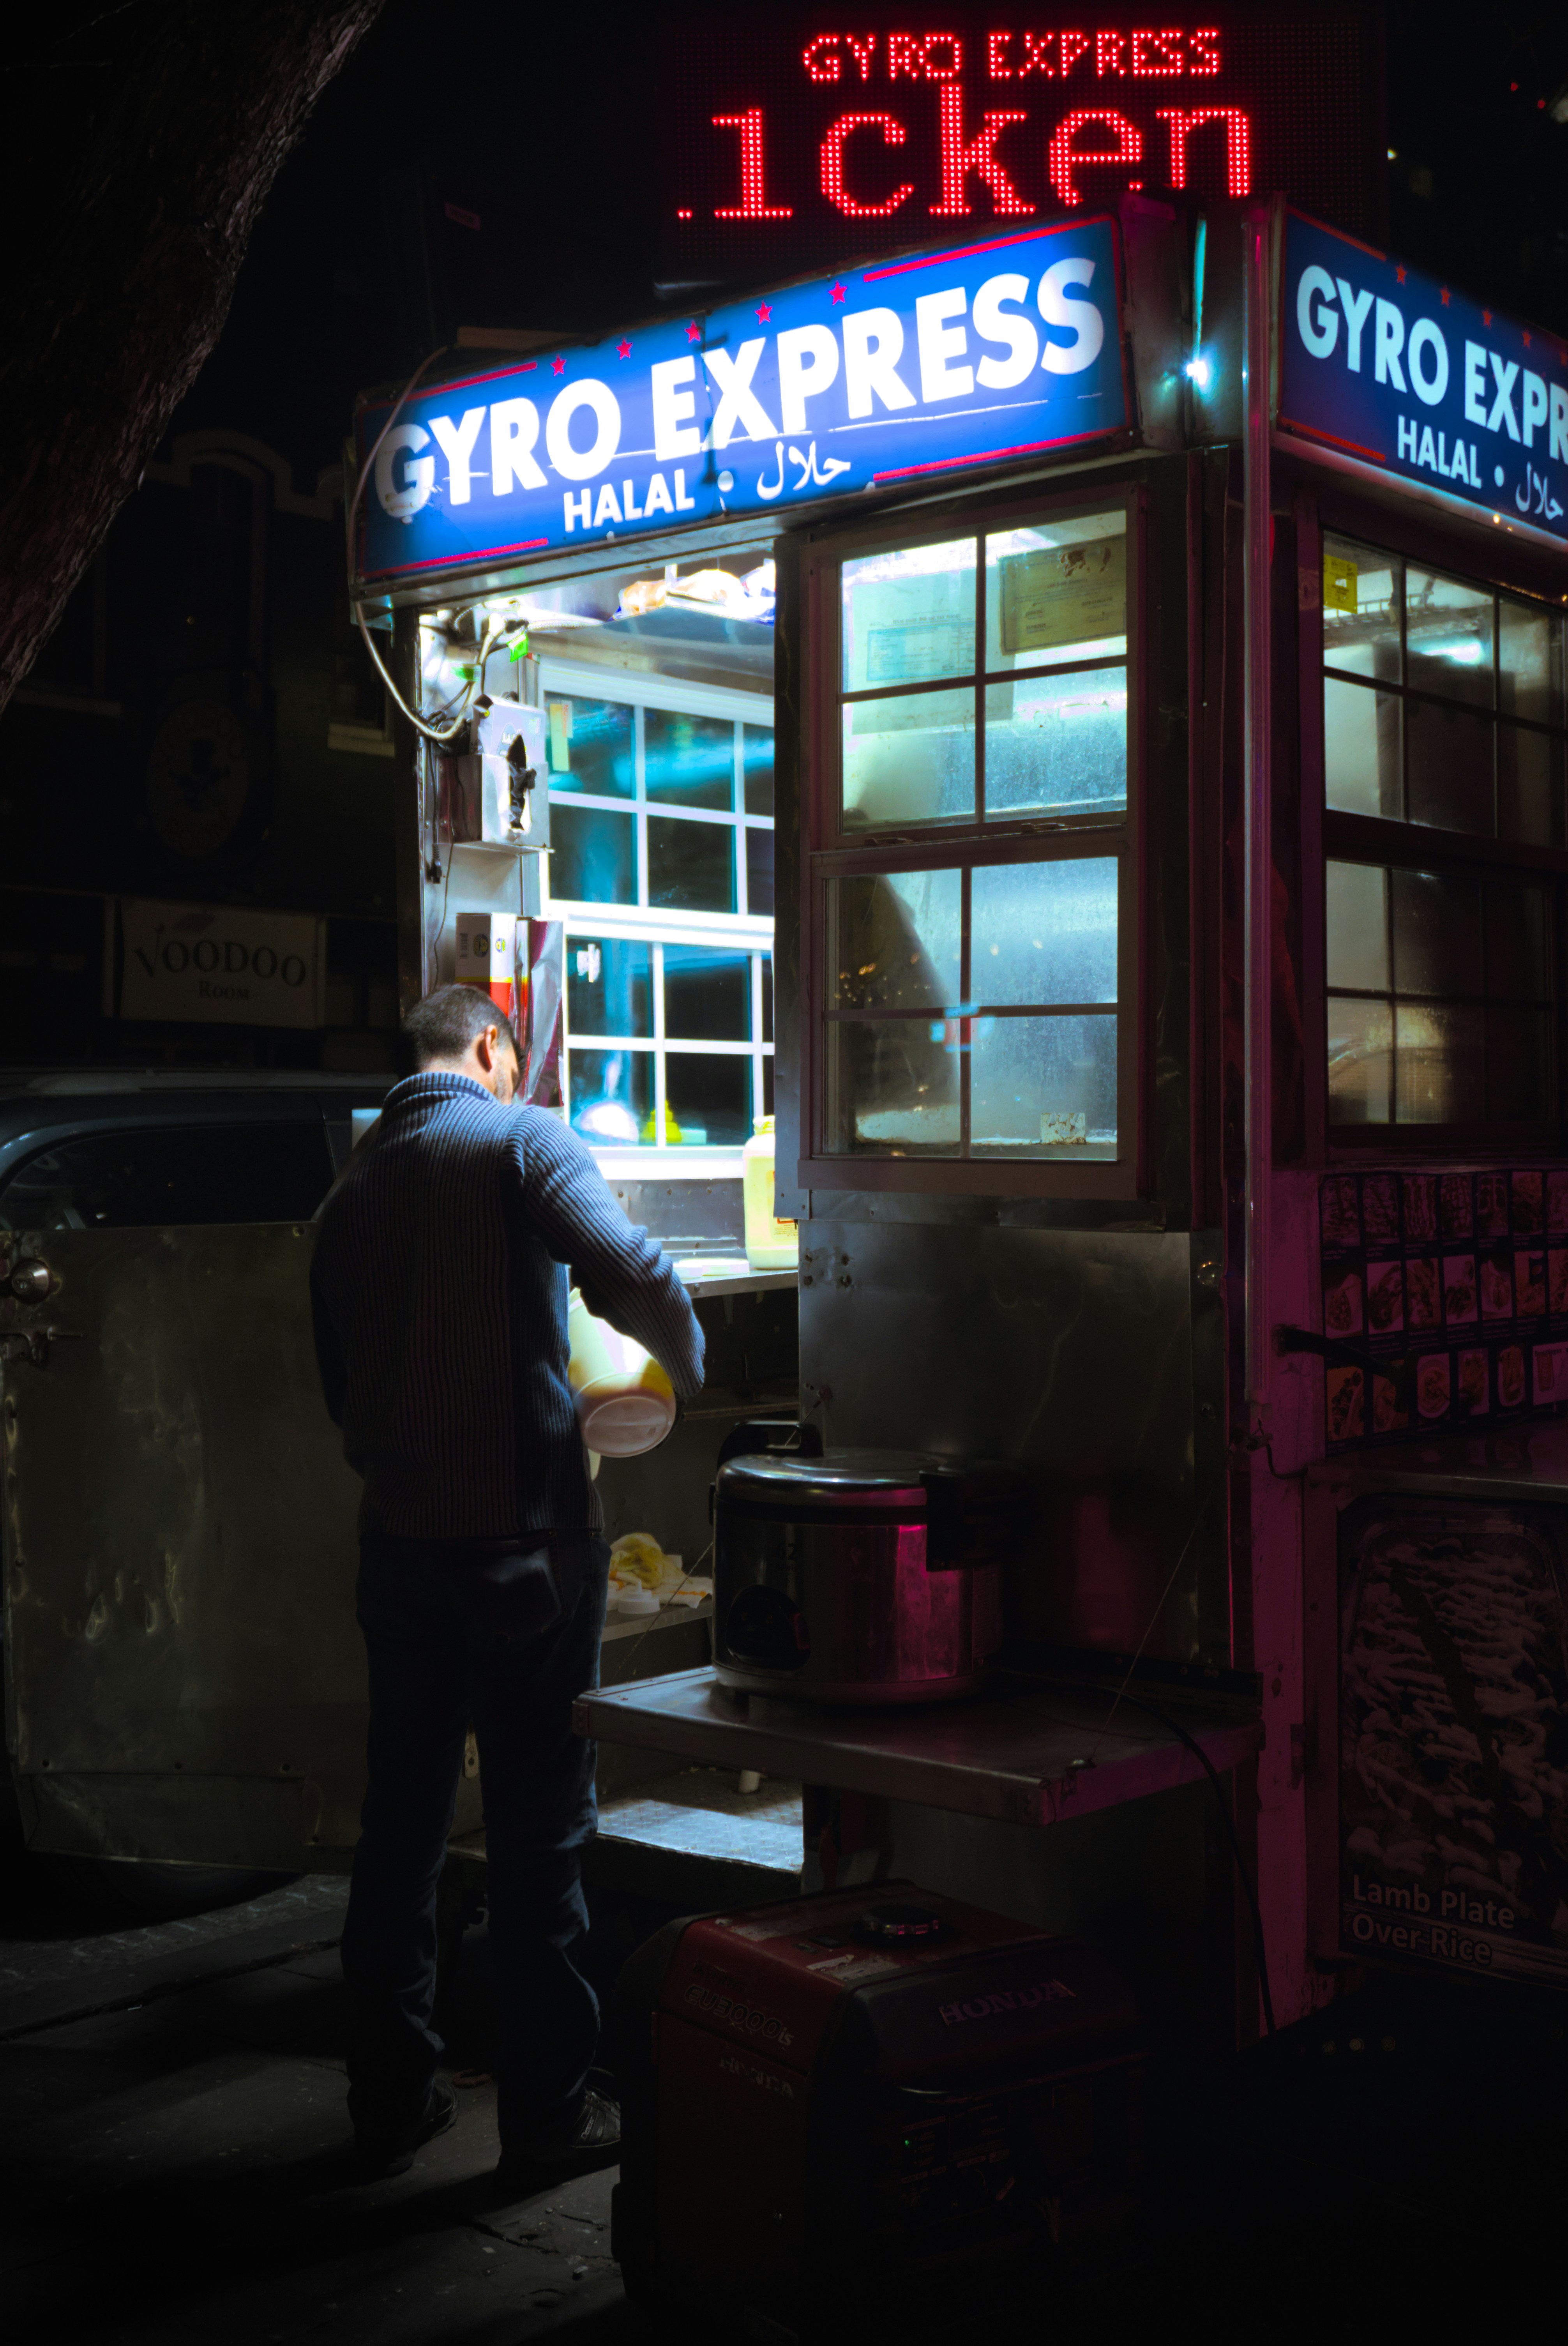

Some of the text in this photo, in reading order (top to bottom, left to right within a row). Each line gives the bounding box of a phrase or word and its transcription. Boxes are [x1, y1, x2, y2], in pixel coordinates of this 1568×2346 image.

[803, 28, 1220, 81] GYRO EXPRESS
[375, 258, 1104, 519] GYRO EXPRESS
[1297, 264, 1568, 466] GYRO EXPR
[757, 440, 851, 500] حلال
[1398, 414, 1482, 490] HALAL
[563, 469, 694, 533] HALAL
[1515, 461, 1564, 520] حلال
[132, 937, 306, 987] VOODOO
[776, 1542, 797, 1561] 62
[1353, 1874, 1515, 1929] Lamb Plate
[1353, 1913, 1492, 1965] Over Rice
[938, 1979, 1075, 2026] HONDA
